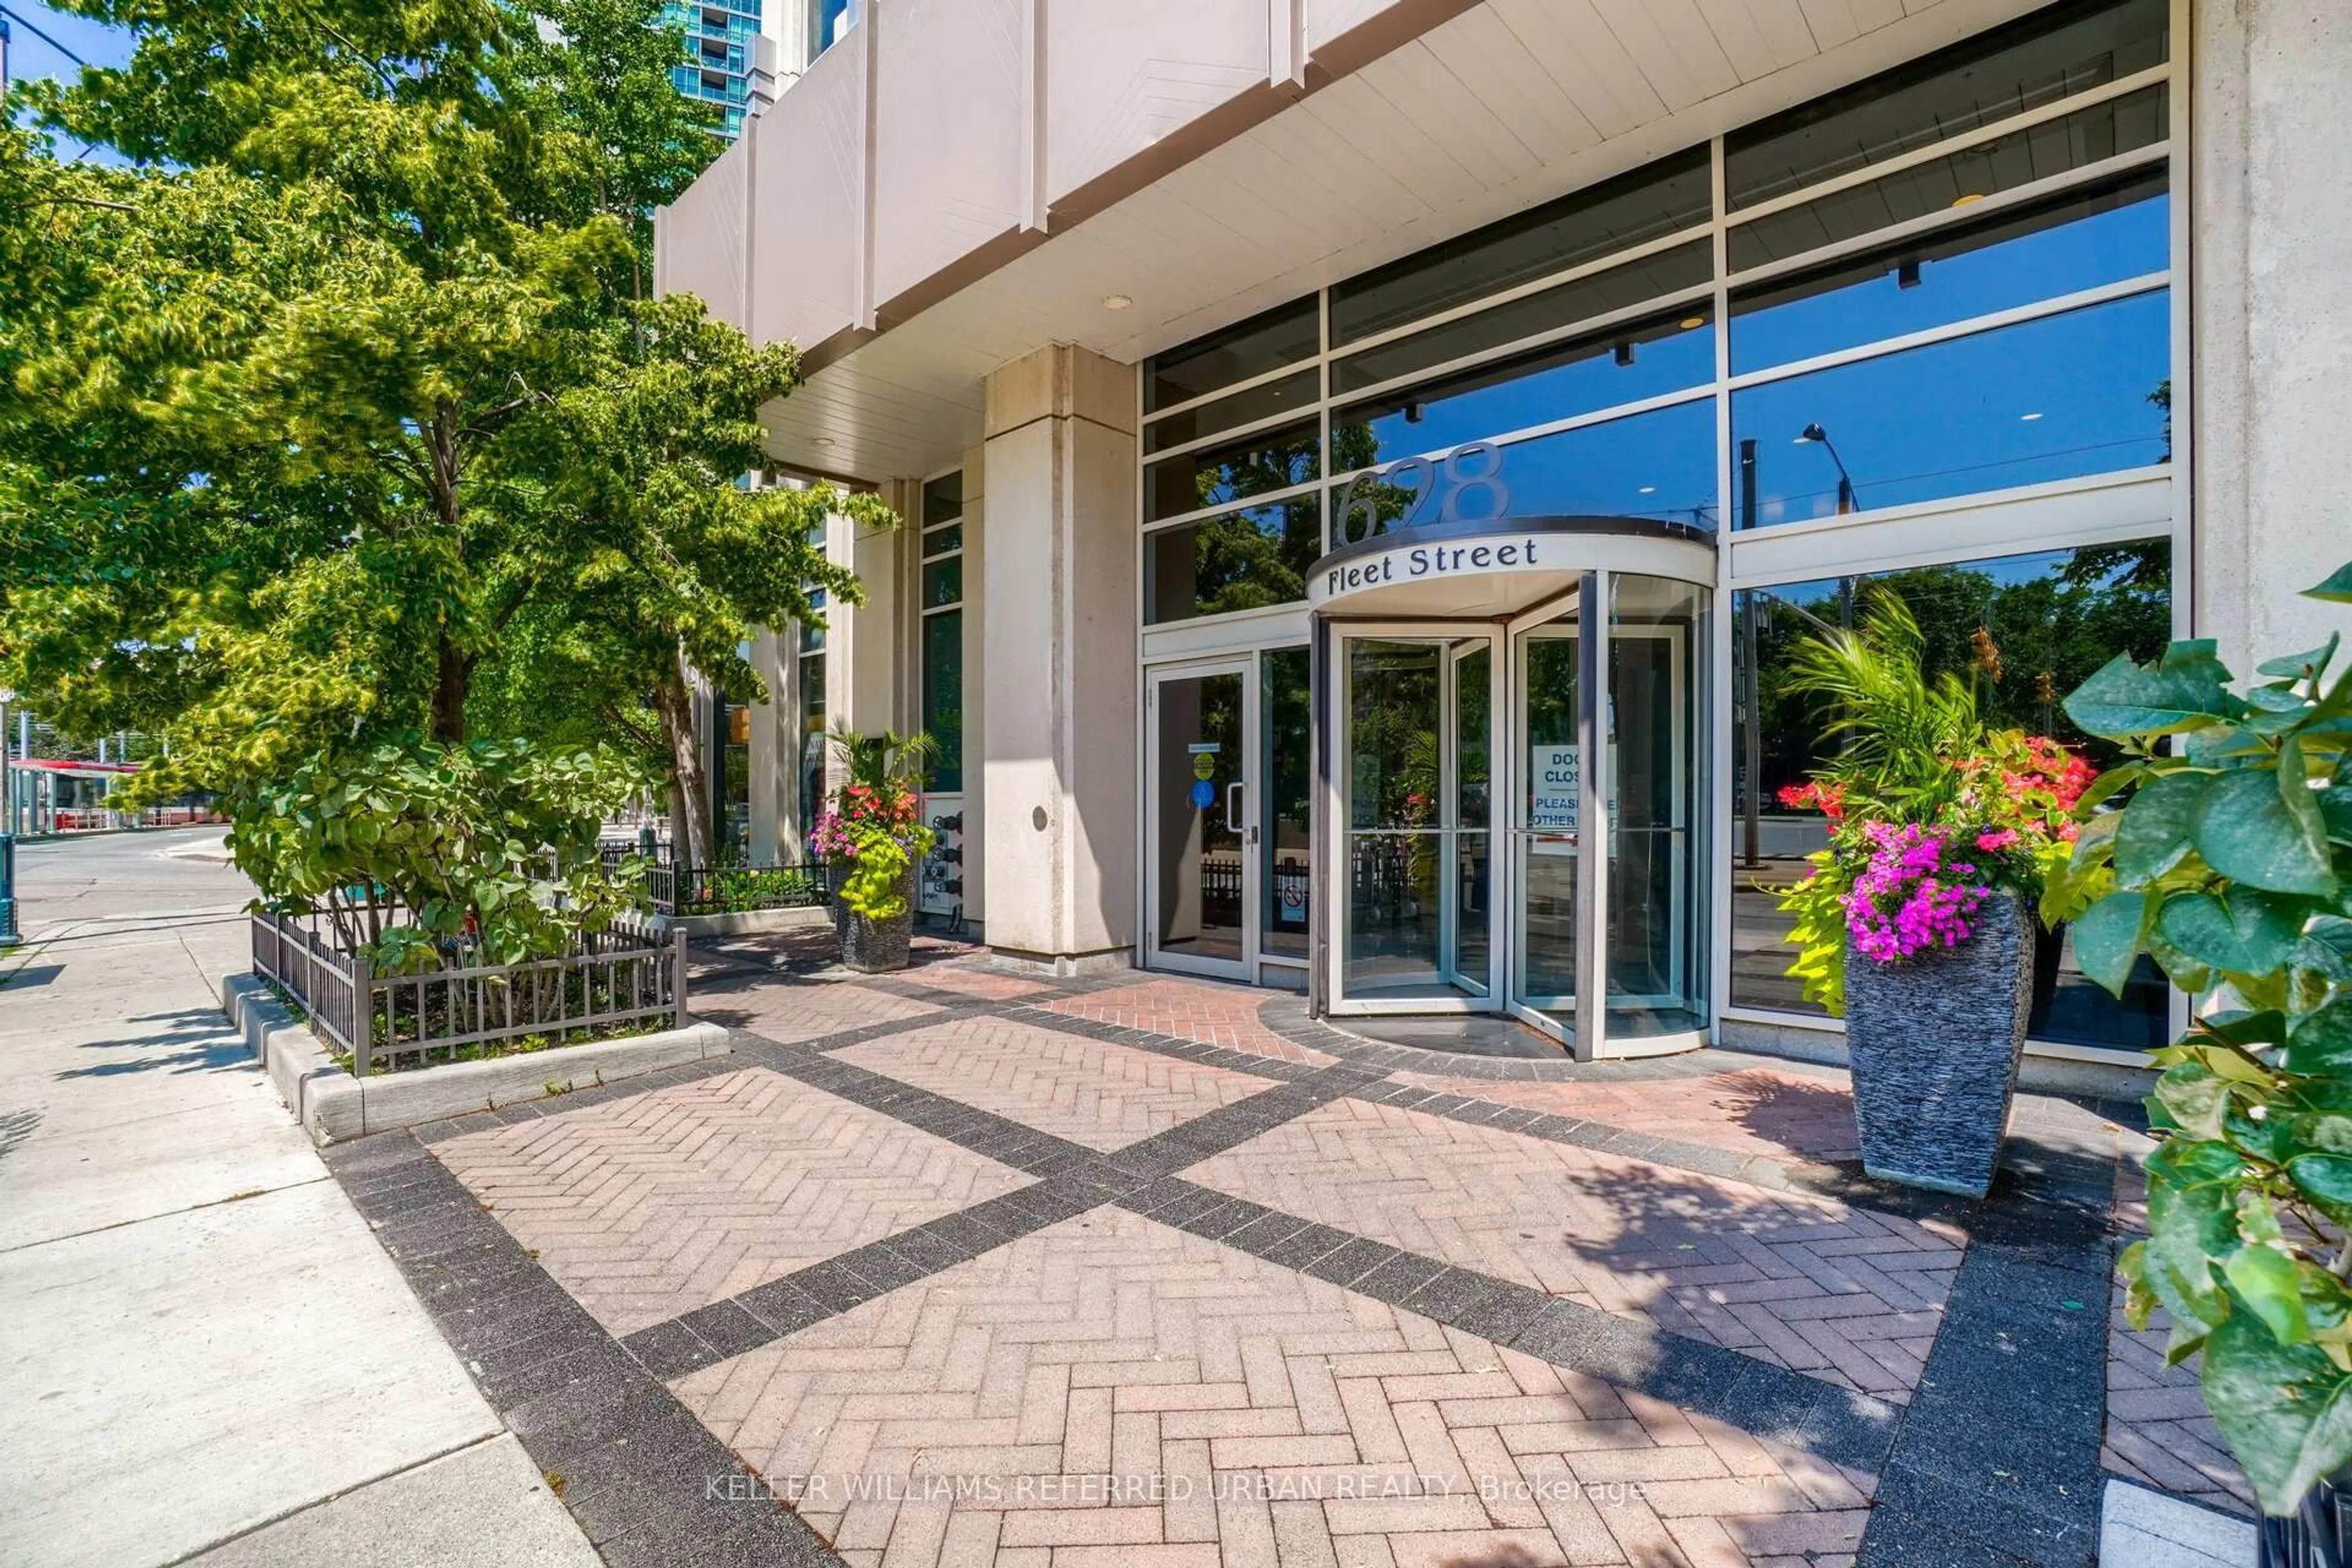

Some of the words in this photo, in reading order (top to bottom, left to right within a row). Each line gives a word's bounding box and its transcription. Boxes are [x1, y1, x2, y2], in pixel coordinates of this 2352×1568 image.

[1338, 441, 1510, 545] 628
[1328, 556, 1392, 595] Fleet
[1409, 539, 1537, 575] Street
[1532, 815, 1575, 826] OTHER
[1536, 799, 1578, 809] PLEAS
